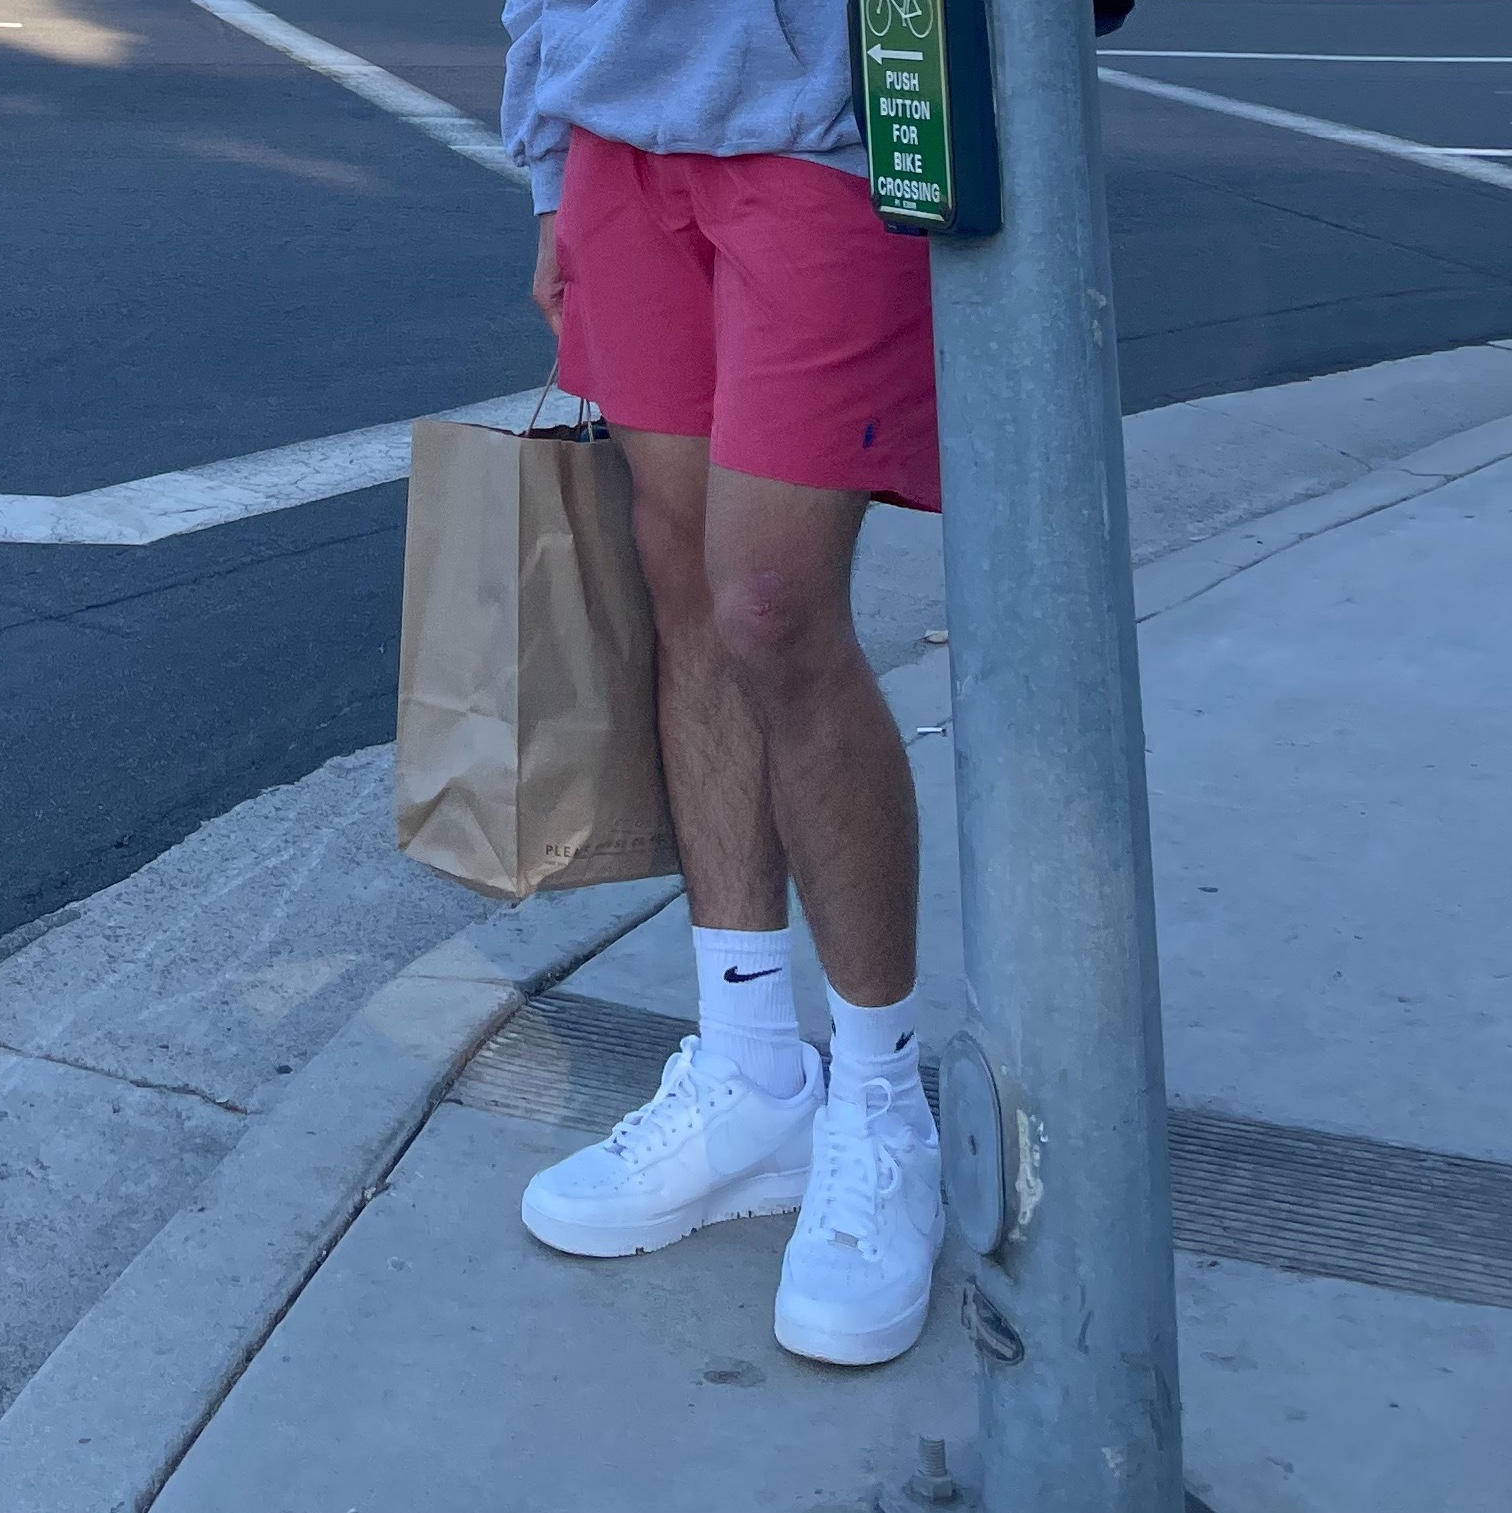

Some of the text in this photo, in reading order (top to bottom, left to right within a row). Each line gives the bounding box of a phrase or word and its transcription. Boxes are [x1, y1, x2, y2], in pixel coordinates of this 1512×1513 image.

[886, 71, 919, 91] PUSH
[879, 97, 930, 120] BUTTON
[892, 124, 918, 145] FOR
[893, 152, 922, 173] BIKE
[877, 176, 940, 203] CROSSING
